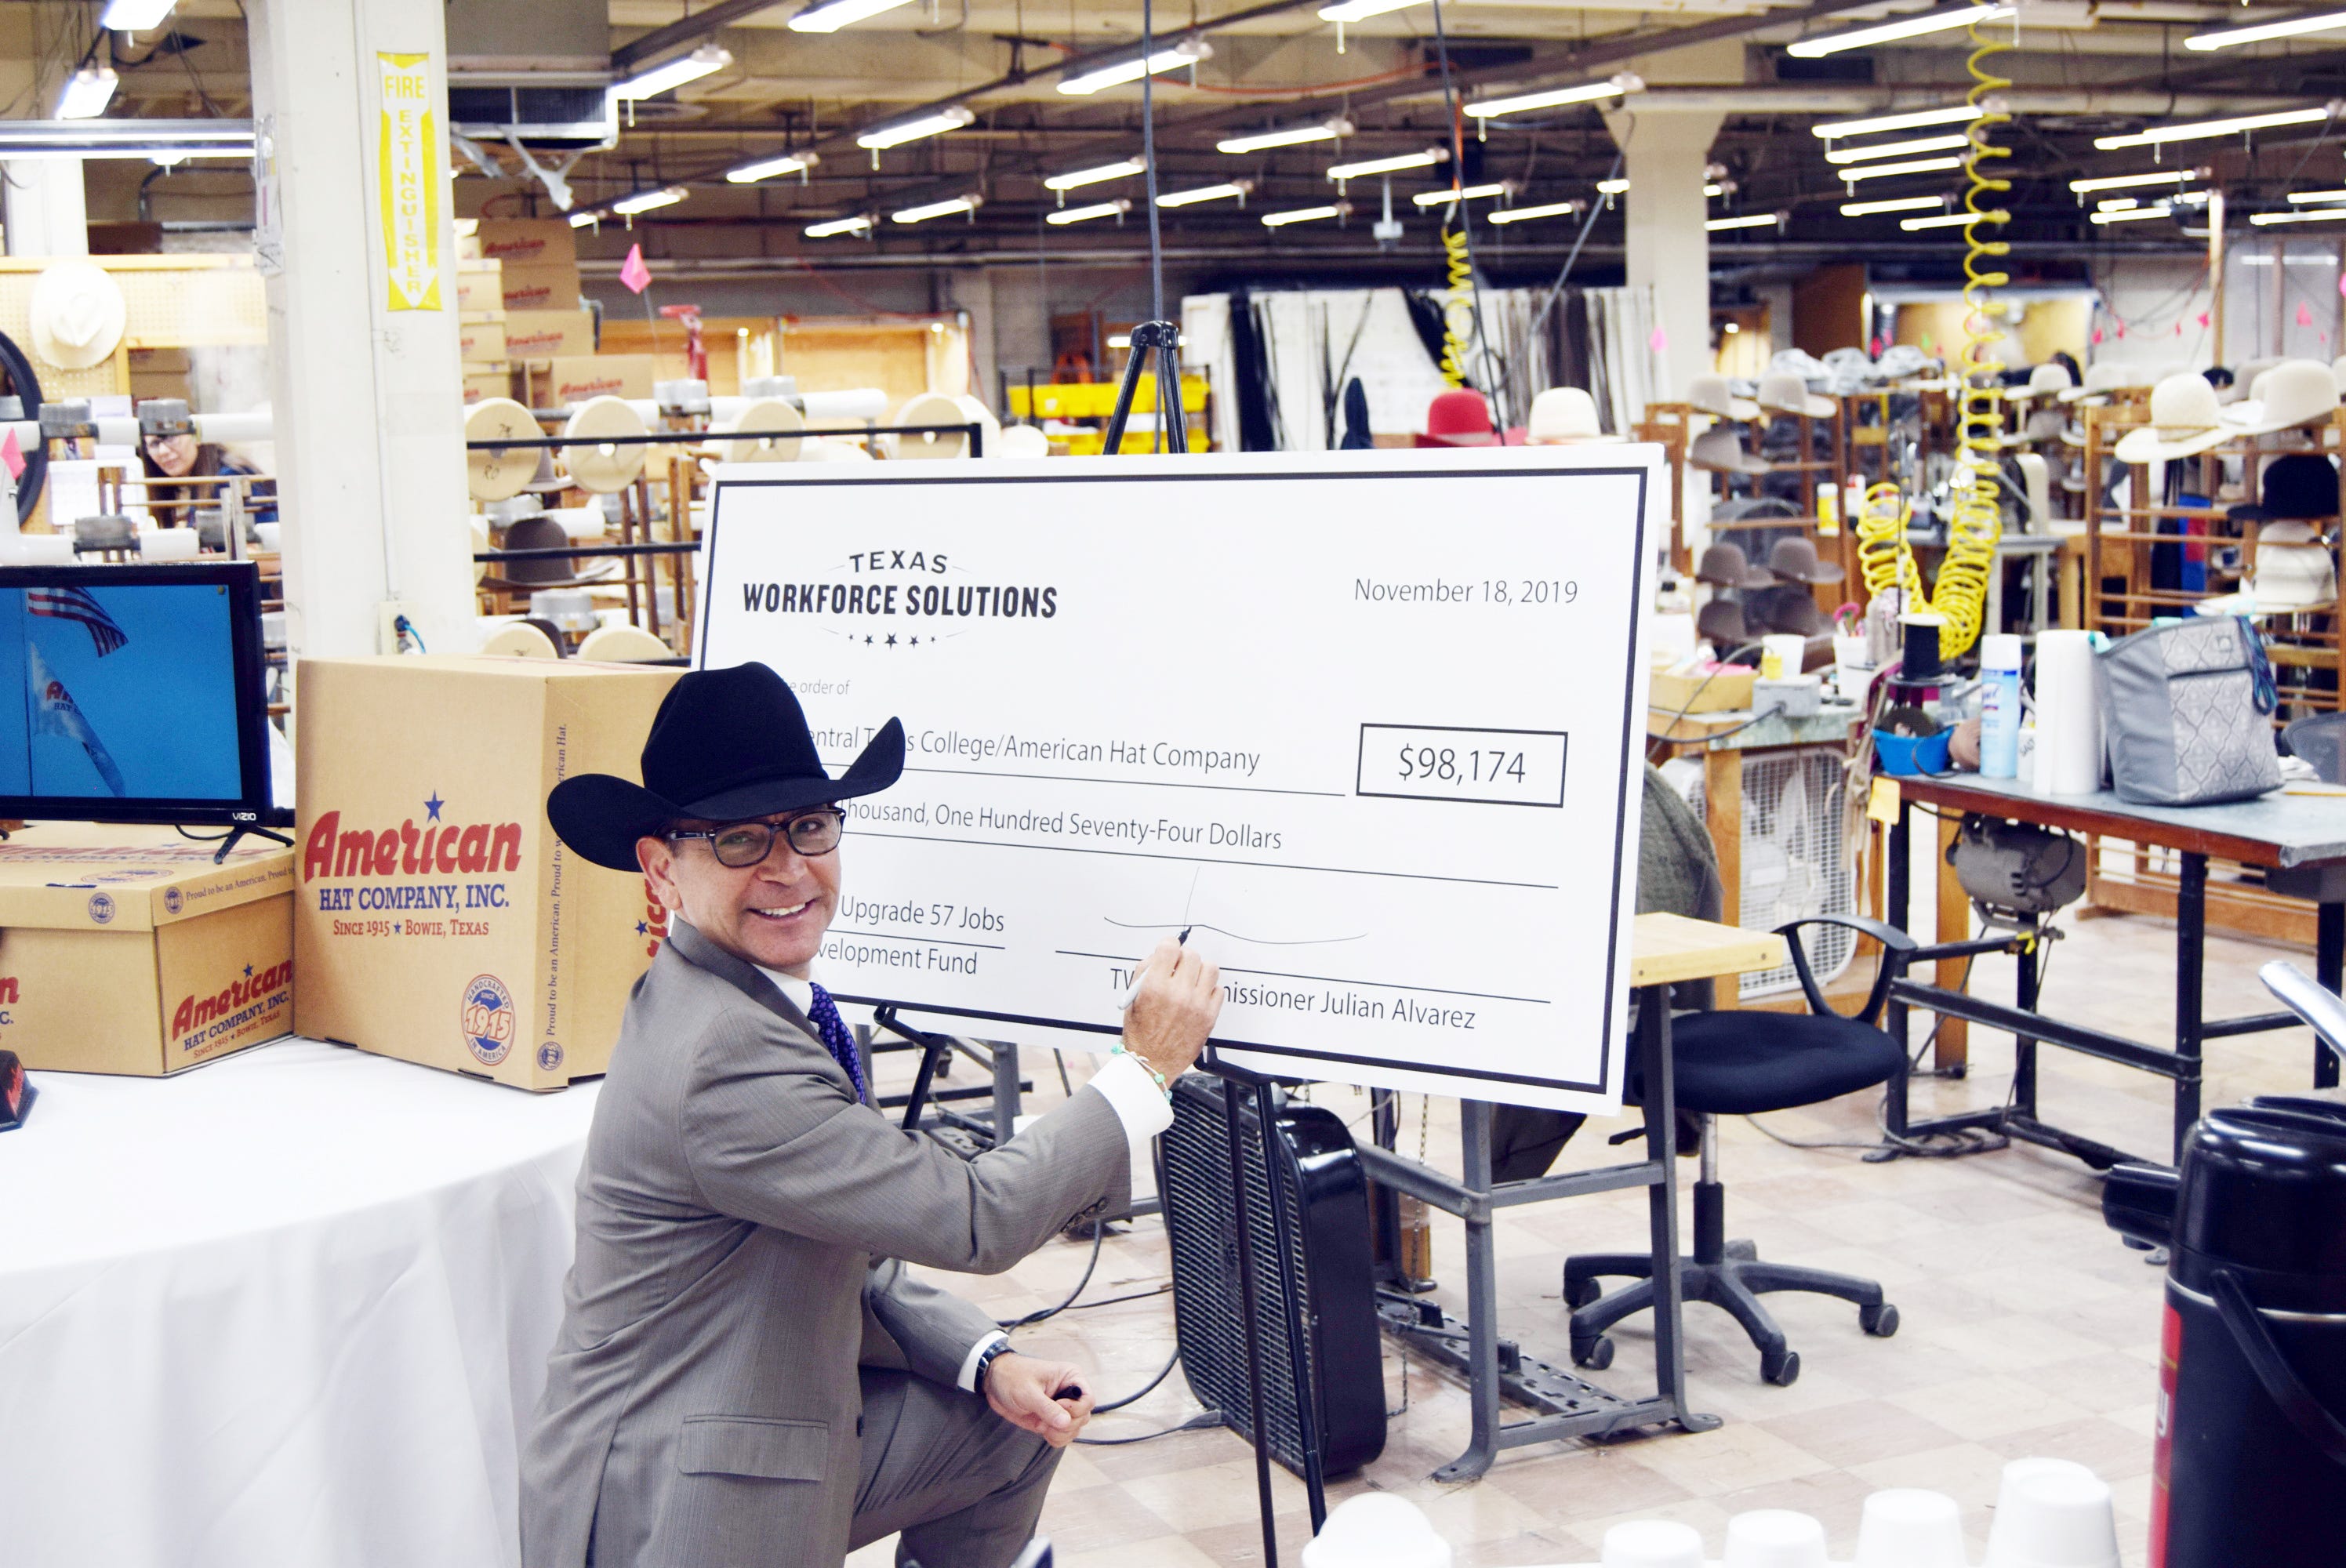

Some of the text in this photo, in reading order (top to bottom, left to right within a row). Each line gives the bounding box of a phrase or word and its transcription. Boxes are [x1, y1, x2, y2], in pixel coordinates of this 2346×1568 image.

[385, 75, 426, 100] FIRE
[398, 109, 422, 294] EXTINGUISHER
[848, 550, 949, 575] TEXAS
[743, 583, 1059, 619] WORKFORCE SOLUTIONS
[1354, 578, 1578, 607] November 18, 2019
[800, 679, 833, 695] order
[837, 680, 851, 695] of
[808, 726, 859, 749] entral
[921, 730, 1103, 763] College/American
[1109, 740, 1147, 764] Hat
[1153, 742, 1261, 777] Company
[1398, 742, 1527, 786] $98,174
[232, 811, 257, 822] VIZIO
[841, 798, 1283, 850] housand, One Hundred Seventy-Four Dollars
[303, 810, 522, 884] American
[554, 850, 561, 862] to
[186, 888, 207, 902] Proud
[208, 887, 216, 895] to
[216, 884, 225, 894] be
[225, 883, 234, 891] an
[267, 866, 288, 880] Proud
[551, 863, 562, 897] Proud
[319, 884, 510, 913] HAT COMPANY, INC.
[841, 895, 1005, 932] Upgrade 57 Jobs
[333, 919, 364, 936] SINCE
[366, 920, 390, 937] 1915
[450, 919, 489, 936] TEXAS
[550, 959, 558, 972] an
[819, 938, 979, 975] velopment Fund
[467, 979, 510, 1010] HANDCRAFTED
[548, 975, 558, 987] be
[549, 989, 557, 1000] to
[172, 959, 294, 1042] American
[1320, 990, 1385, 1020] Julian
[1392, 999, 1476, 1030] Alvarez
[183, 1030, 206, 1051] HAT
[267, 990, 289, 1010] INC.
[465, 1004, 512, 1041] 1915
[546, 1003, 557, 1036] Proud
[478, 1045, 507, 1060] AMERICA
